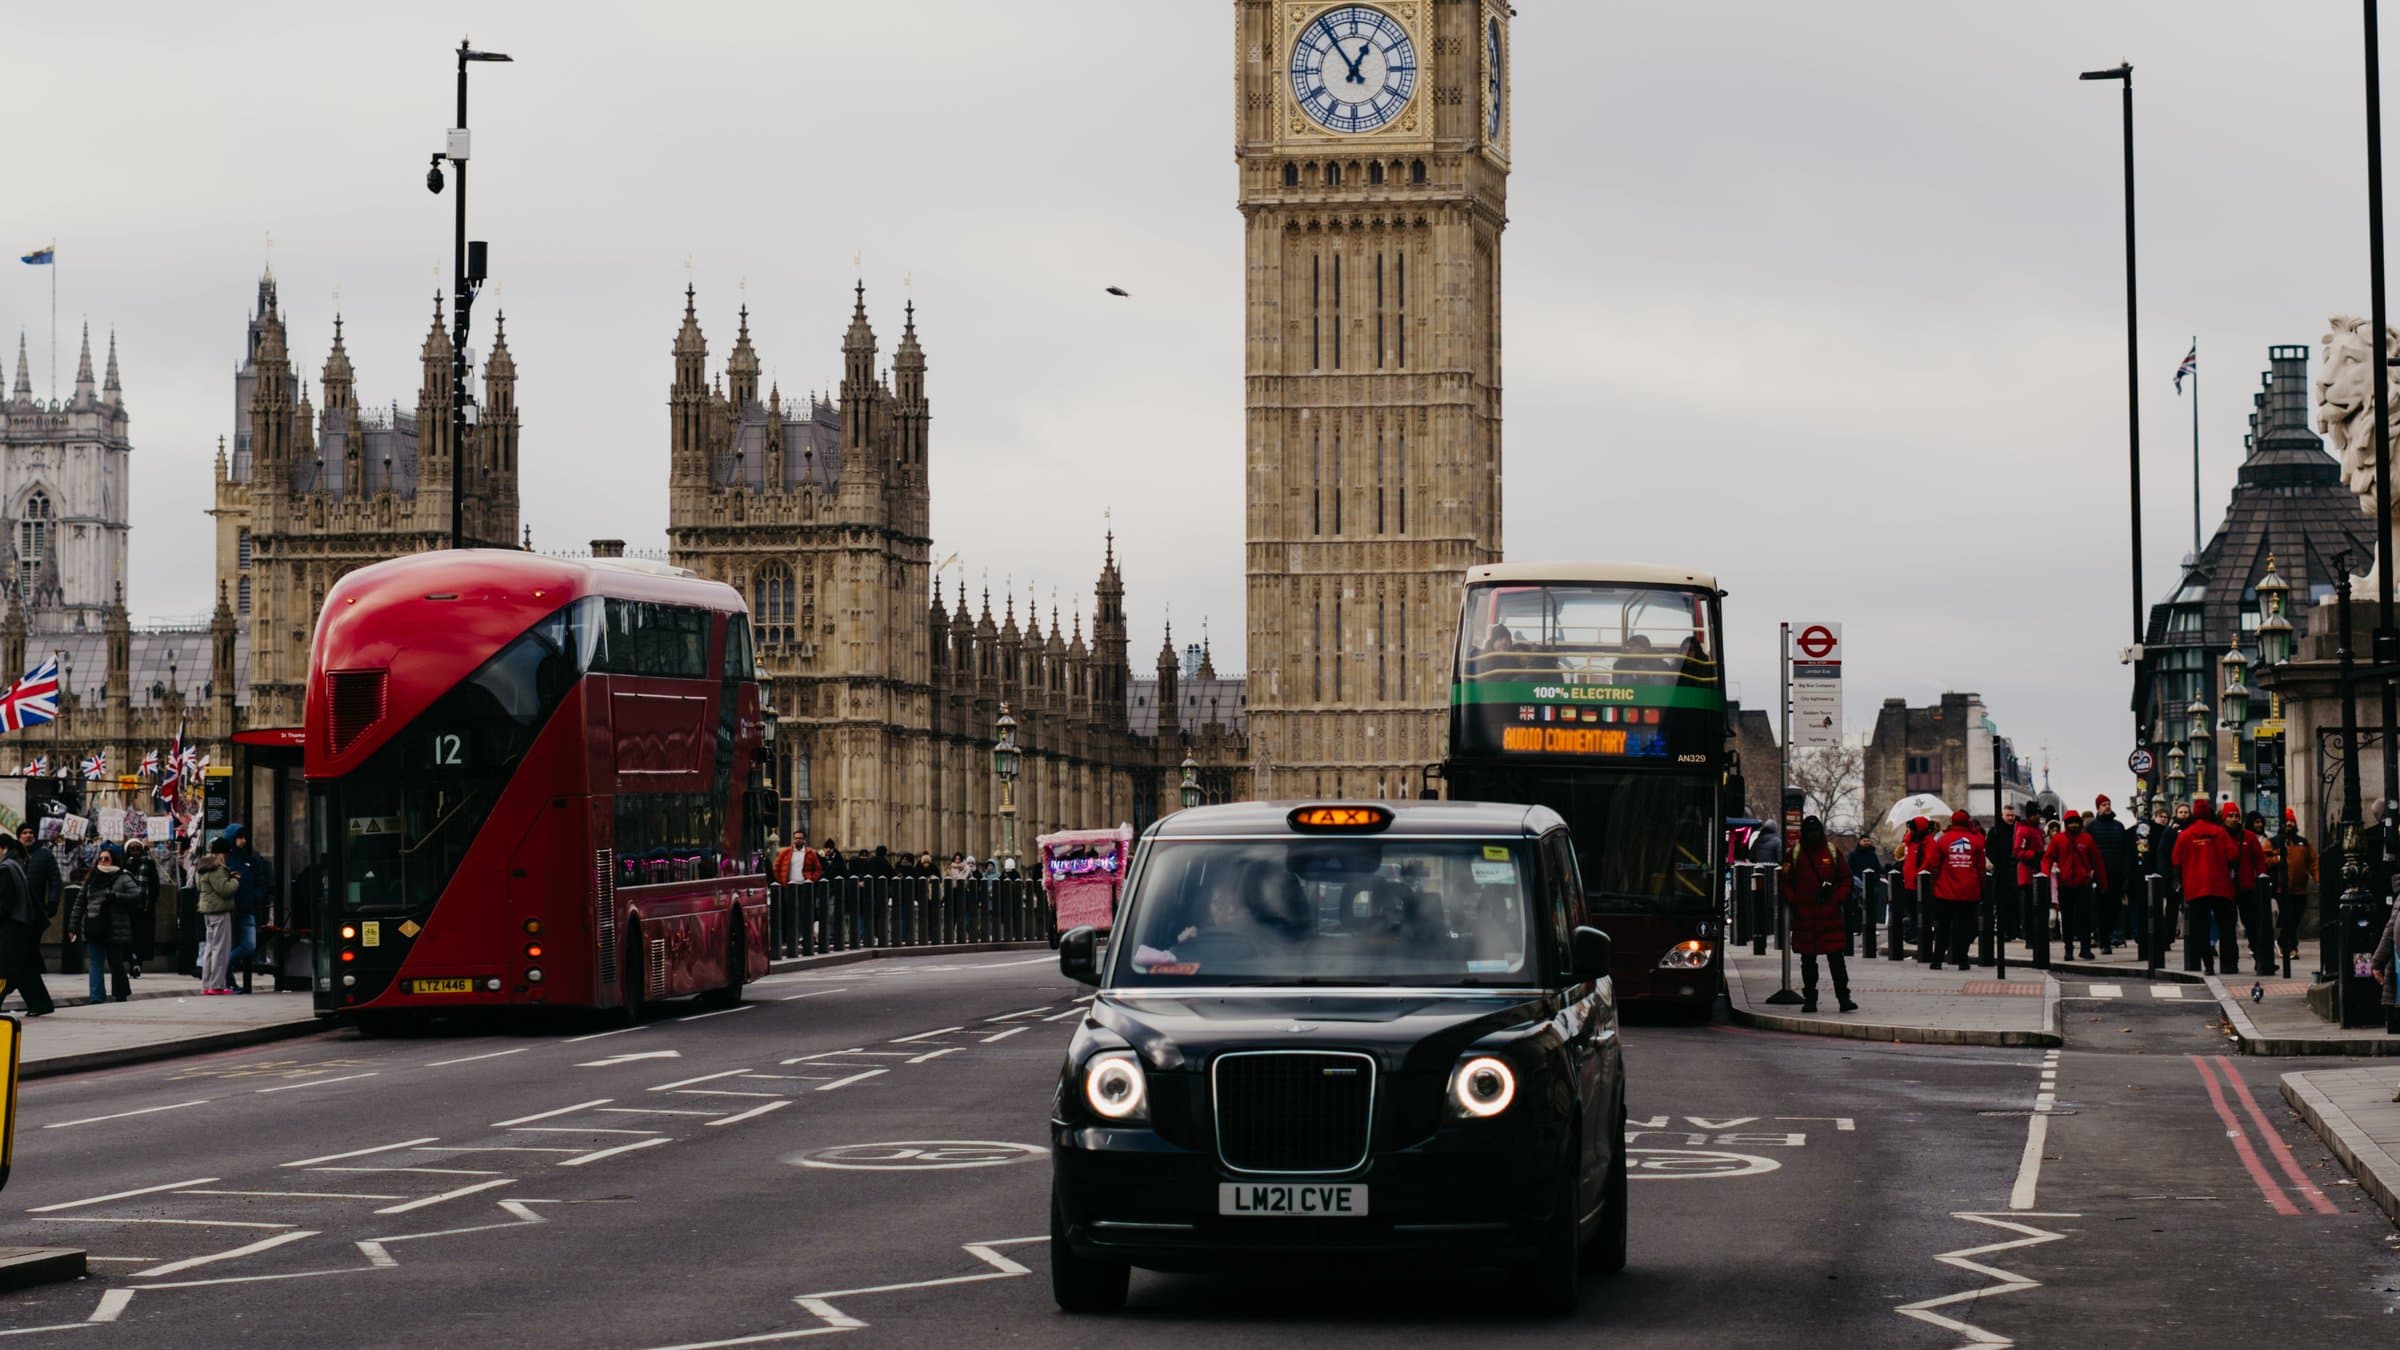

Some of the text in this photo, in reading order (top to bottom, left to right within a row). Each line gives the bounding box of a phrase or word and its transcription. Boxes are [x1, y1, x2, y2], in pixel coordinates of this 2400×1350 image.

[1533, 686, 1635, 700] 100% ELECTRIC
[1503, 726, 1543, 750] AUDIO
[435, 733, 462, 765] 12
[1677, 754, 1706, 763] AN329
[1305, 809, 1373, 824] TAXI
[418, 981, 440, 992] LTZ
[1235, 1187, 1353, 1212] LM21 CVE
